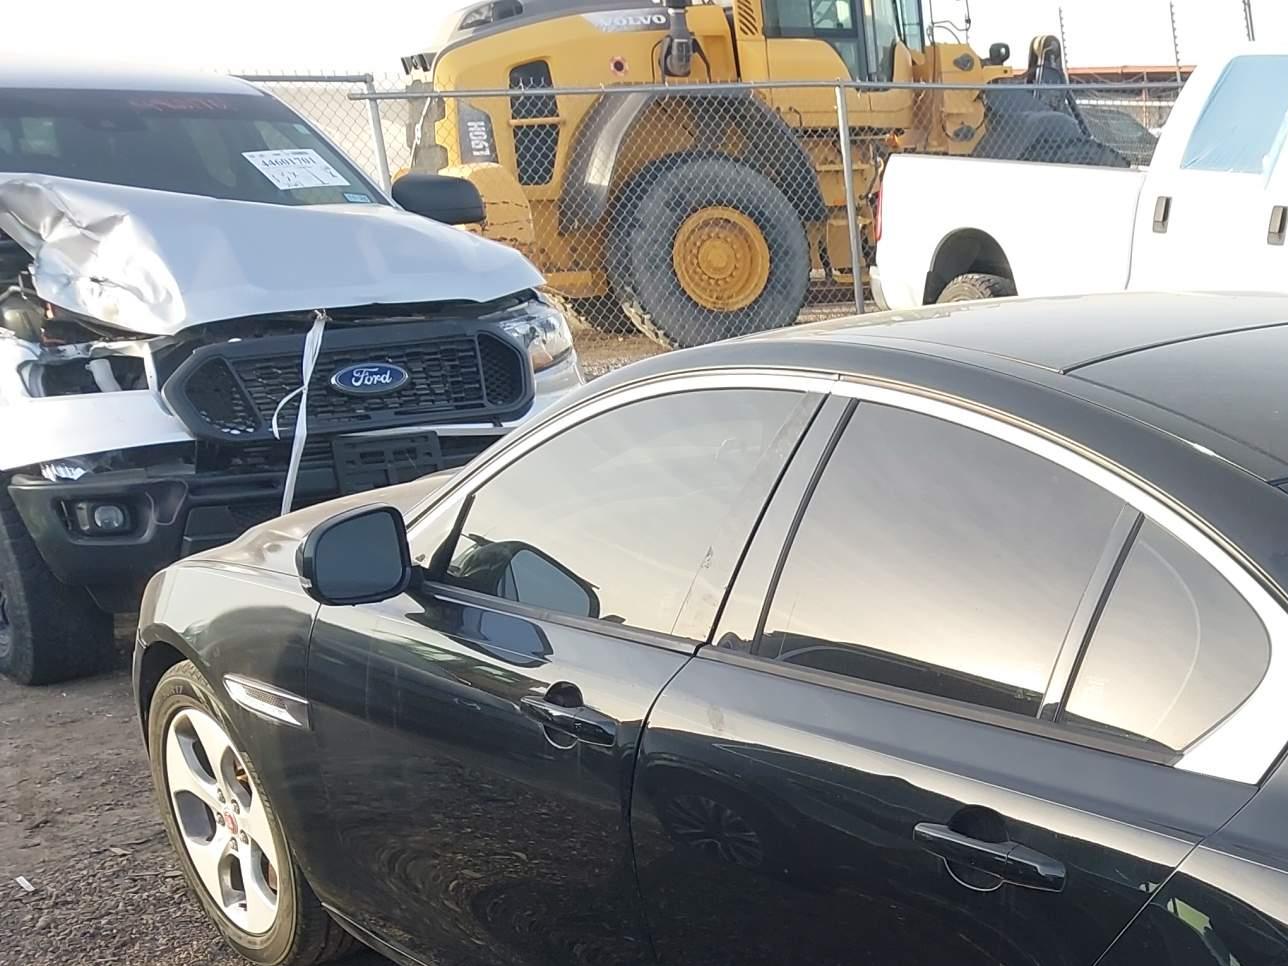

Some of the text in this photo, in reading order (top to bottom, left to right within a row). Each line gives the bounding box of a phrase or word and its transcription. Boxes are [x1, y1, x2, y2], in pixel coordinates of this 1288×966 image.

[600, 14, 667, 26] VOLVO
[467, 121, 490, 156] L90H
[351, 367, 393, 387] Ford
